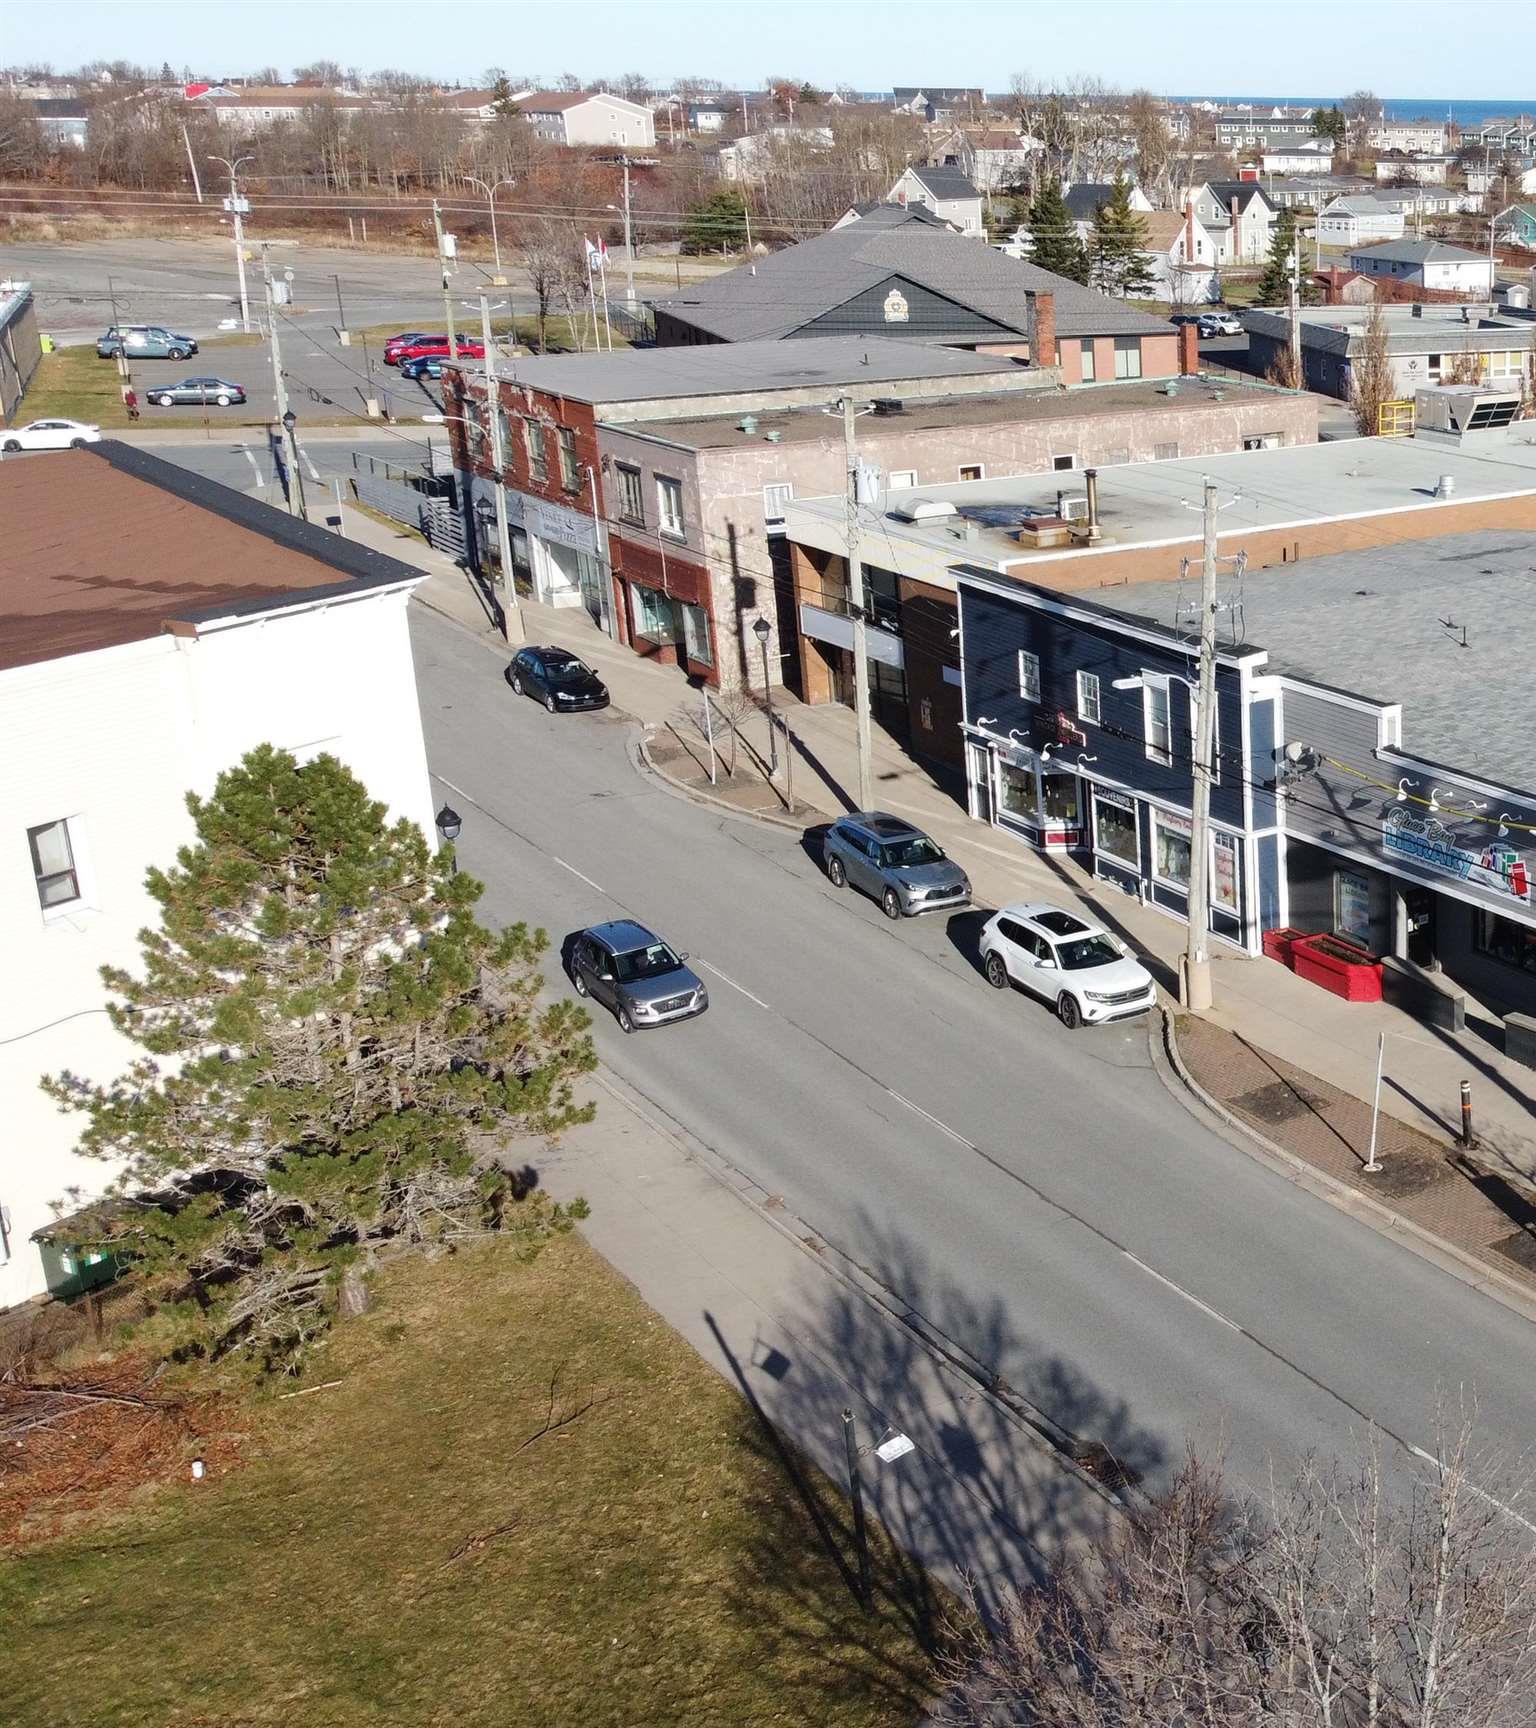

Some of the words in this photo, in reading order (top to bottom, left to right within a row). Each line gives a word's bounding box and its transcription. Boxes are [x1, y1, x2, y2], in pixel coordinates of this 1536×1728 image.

[1385, 826, 1474, 880] LIBRARY
[1388, 807, 1425, 834] Glace
[1425, 818, 1456, 851] Bay
